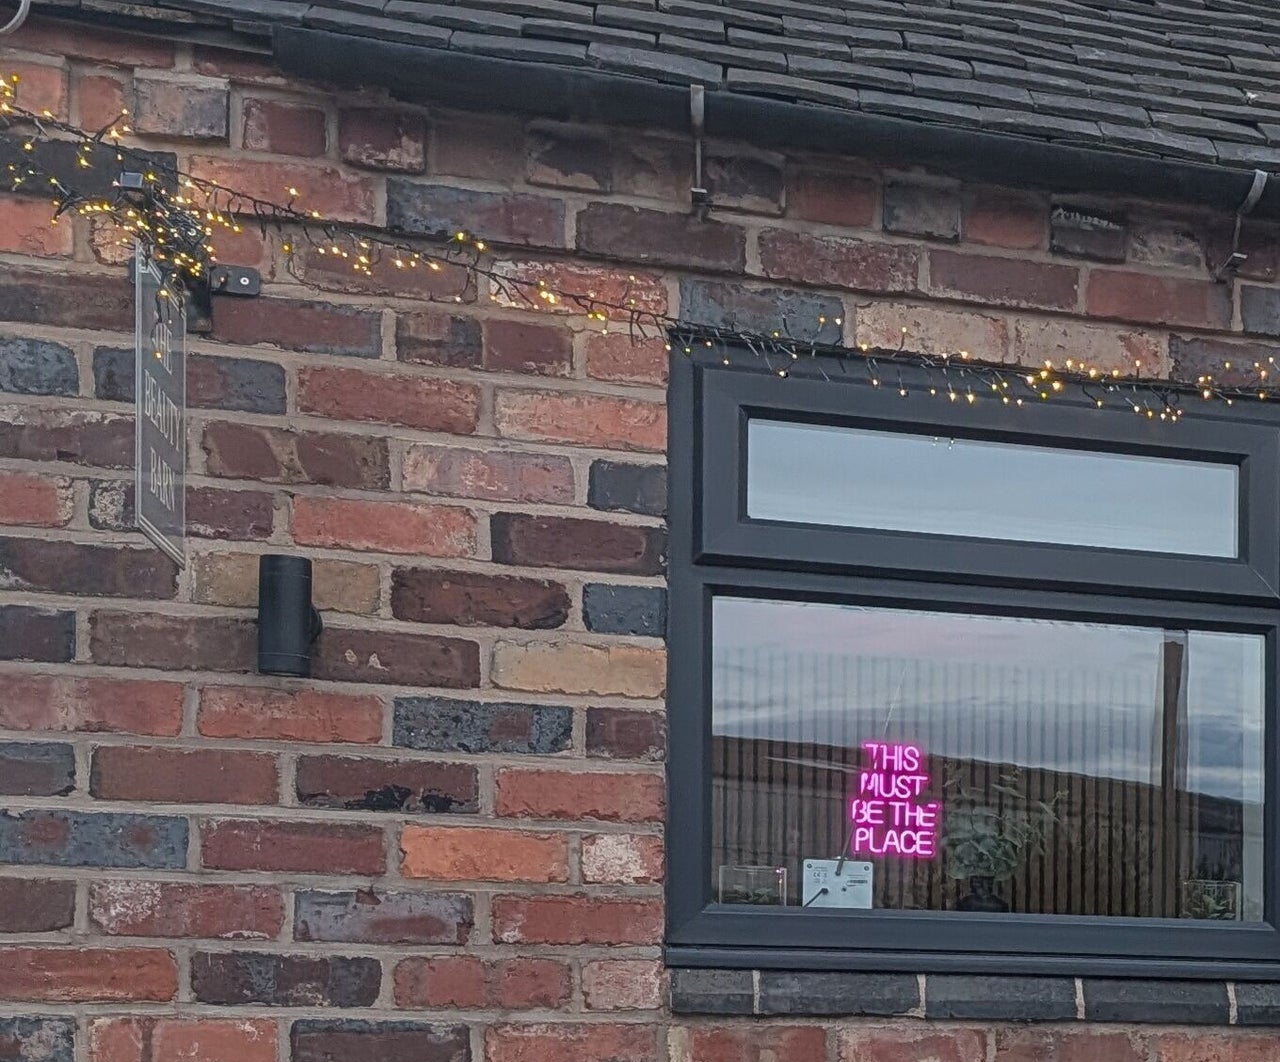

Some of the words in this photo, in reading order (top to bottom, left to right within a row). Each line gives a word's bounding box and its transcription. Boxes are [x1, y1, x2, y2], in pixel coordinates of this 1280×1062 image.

[144, 368, 181, 452] BEAUTY
[150, 446, 176, 513] BARN
[864, 743, 920, 772] THIS
[860, 772, 929, 799] MUST
[851, 799, 885, 824] BE
[888, 801, 938, 827] THE
[855, 827, 933, 855] PLACE
